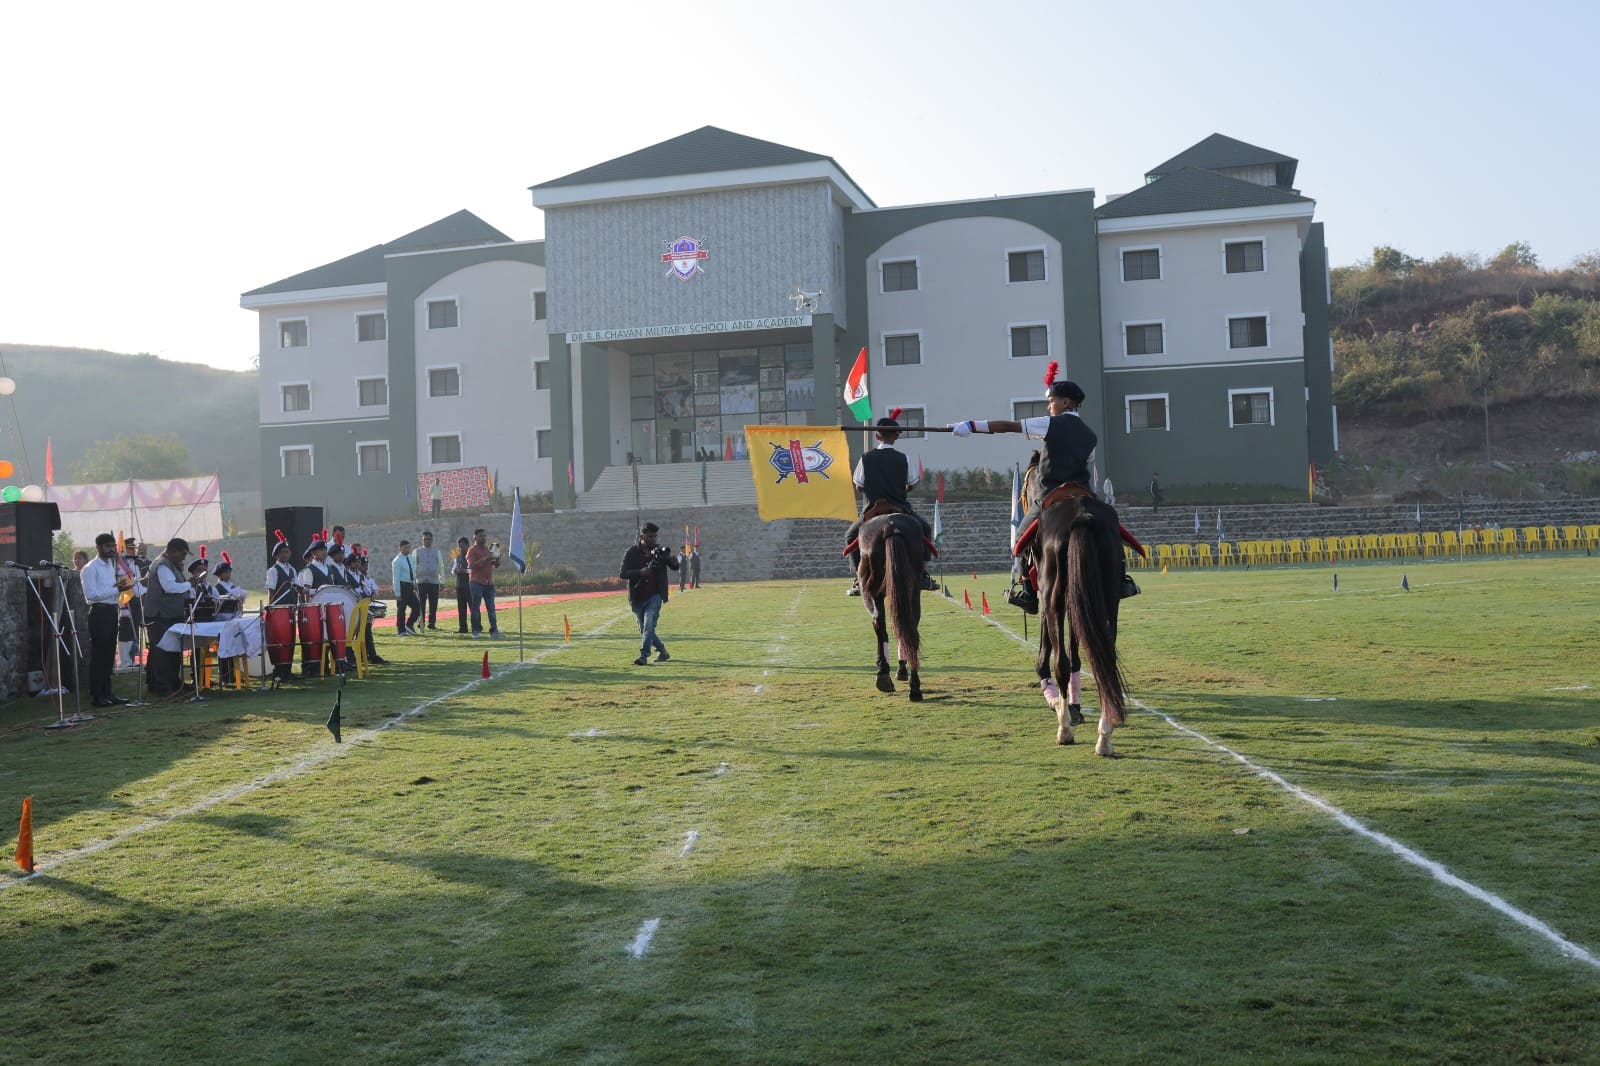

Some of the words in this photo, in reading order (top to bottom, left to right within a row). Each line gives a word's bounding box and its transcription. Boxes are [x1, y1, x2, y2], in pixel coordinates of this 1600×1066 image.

[645, 325, 686, 336] MILITARY
[689, 322, 729, 333] SCHOOL
[732, 320, 753, 330] AND
[756, 316, 805, 328] ACADEMY
